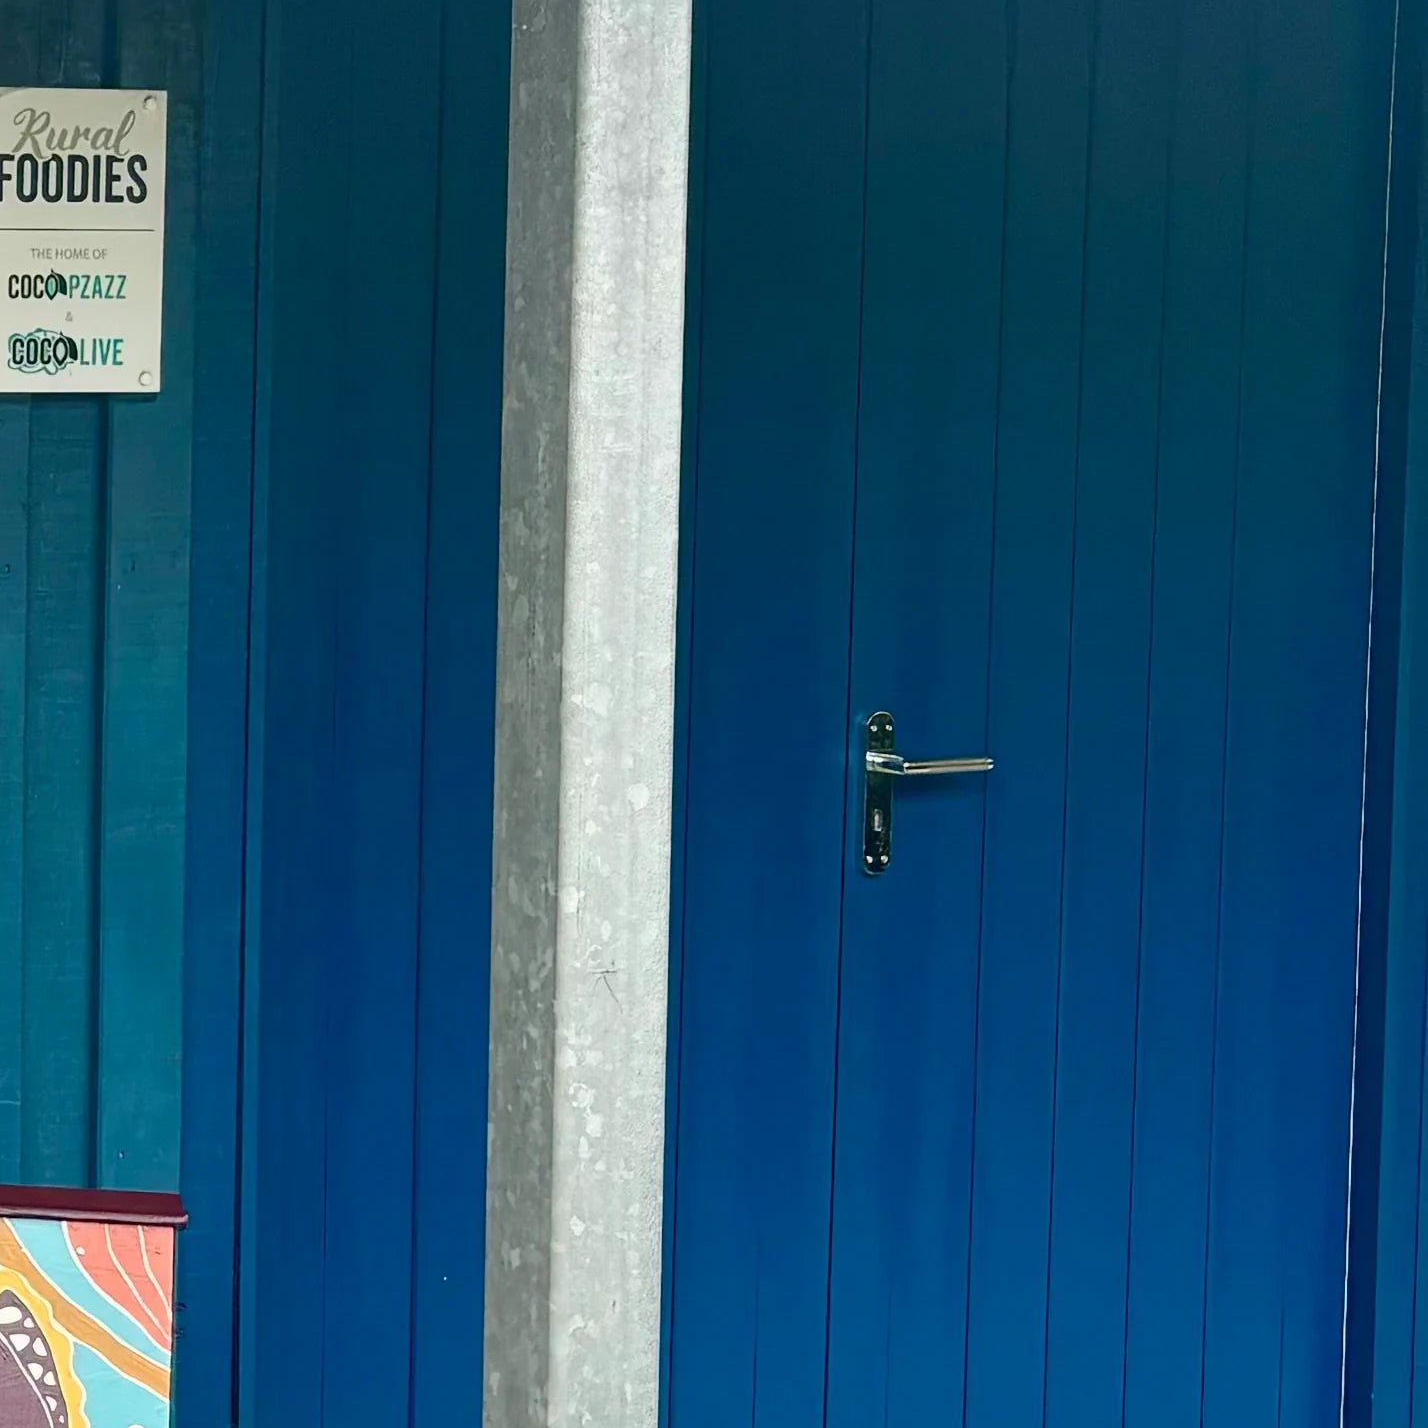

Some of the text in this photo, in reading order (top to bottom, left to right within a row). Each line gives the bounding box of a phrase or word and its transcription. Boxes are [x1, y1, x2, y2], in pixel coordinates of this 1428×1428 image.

[11, 108, 135, 159] Rural
[30, 248, 108, 260] THE HOME OF
[68, 274, 126, 300] PZAZZ
[65, 310, 74, 322] &
[80, 338, 124, 366] LIVE
